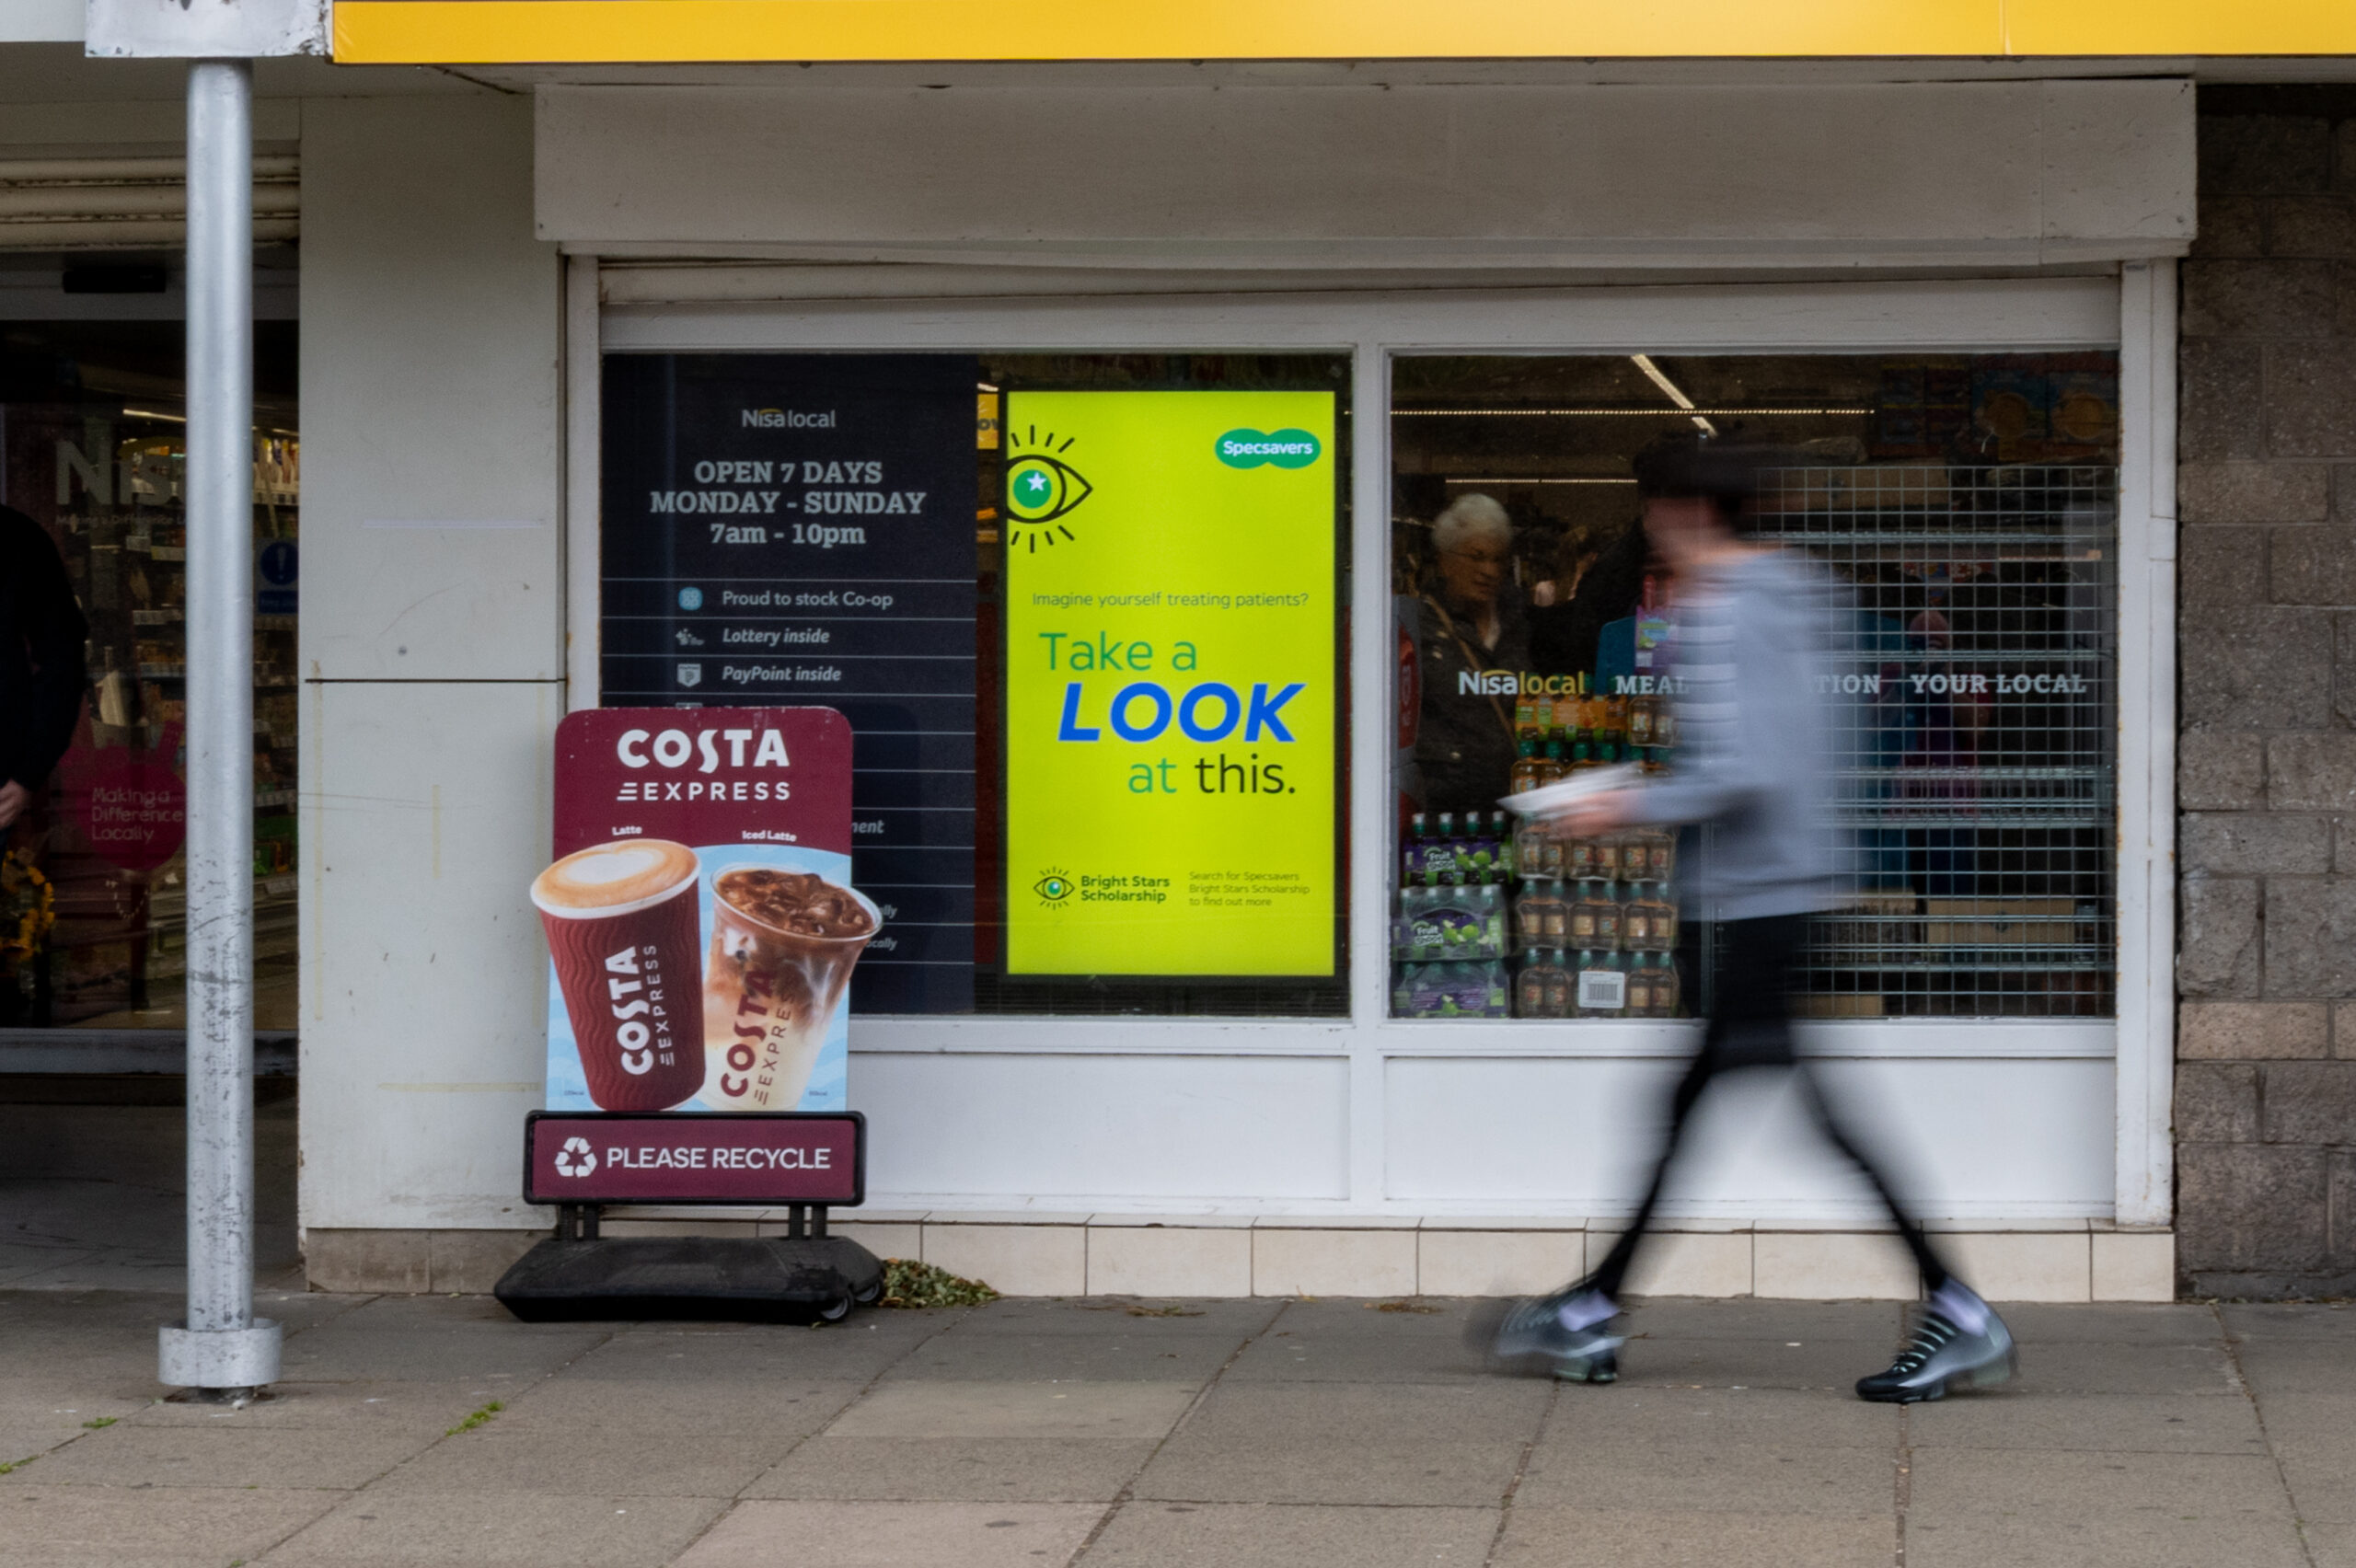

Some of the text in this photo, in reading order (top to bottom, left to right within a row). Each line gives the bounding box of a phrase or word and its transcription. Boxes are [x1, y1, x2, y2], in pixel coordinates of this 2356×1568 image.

[742, 409, 836, 428] Nisalocal
[1223, 441, 1312, 457] Specsavers
[694, 461, 883, 484] OPEN 7 DAYS
[650, 491, 780, 513] MONDAY
[803, 492, 926, 514] SUNDAY
[710, 524, 768, 544] 7am
[791, 524, 866, 548] 10pm
[722, 591, 894, 610] Proud to stock Co-op
[1033, 592, 1309, 609] Imagine yourself treating patients?
[722, 628, 830, 647] Lottery inside
[1038, 630, 1197, 671] Take a
[722, 666, 841, 685] PayPoint inside
[1459, 670, 1586, 695] Nisalocal
[1615, 674, 1881, 695] MEAL TION
[1911, 674, 2086, 694] YOUR LOCAL
[1057, 682, 1307, 744] LOOK
[617, 729, 790, 774] COSTA
[1128, 754, 1295, 794] at this.
[91, 787, 170, 808] Making a
[643, 782, 790, 801] EXPRESS
[92, 805, 184, 823] Difference
[92, 825, 155, 845] Locally
[612, 825, 642, 836] Latte
[742, 830, 797, 843] Iced Latte
[1081, 875, 1170, 890] Bright Stars
[1189, 871, 1299, 882] Search for Specsavers
[1081, 889, 1166, 904] Scholarship
[1189, 884, 1311, 894] Bright Stars Scholarship
[1189, 897, 1200, 905] to
[1203, 896, 1222, 905] find
[643, 945, 673, 1050] EXPRESS
[605, 946, 654, 1076] COSTA
[720, 967, 779, 1099] COSTA
[757, 992, 797, 1089] EXPRESS
[606, 1147, 831, 1170] PLEASE RECYCLE
